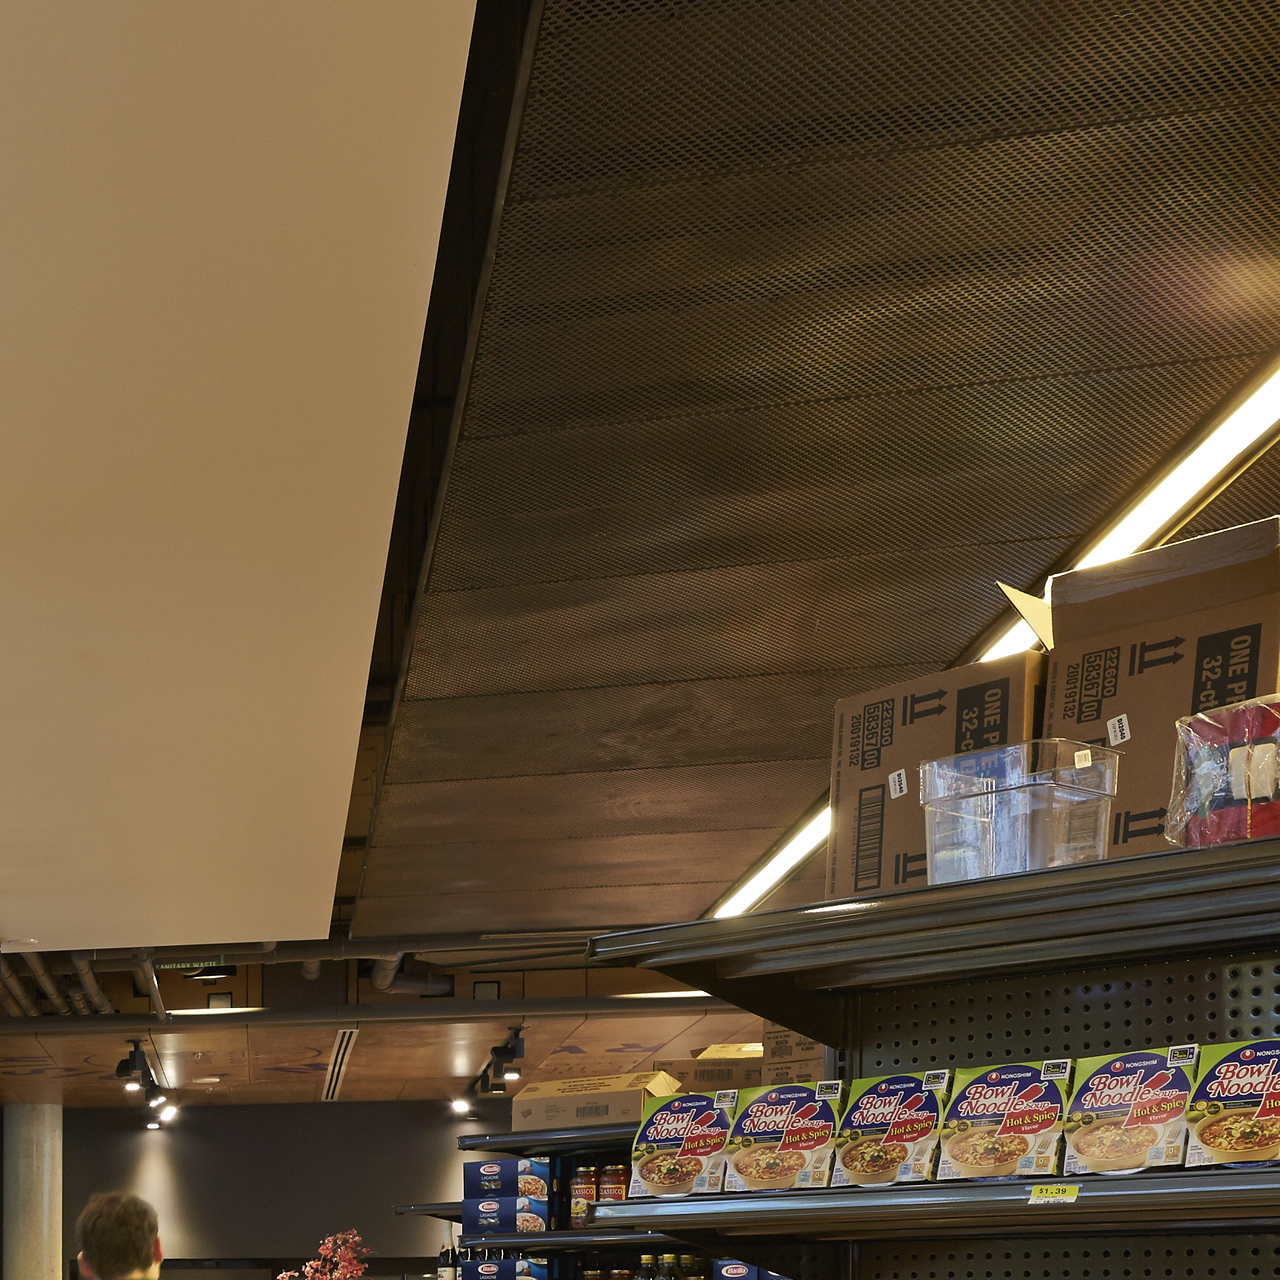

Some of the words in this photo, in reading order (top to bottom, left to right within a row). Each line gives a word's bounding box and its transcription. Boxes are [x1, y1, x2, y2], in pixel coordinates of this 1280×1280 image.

[1229, 634, 1250, 674] ONE
[1082, 653, 1104, 723] 5836700
[1101, 649, 1119, 697] 22600
[983, 687, 1002, 726] ONE
[1063, 663, 1079, 720] 20019132
[864, 704, 881, 770] 5836700
[881, 701, 892, 747] 22600
[849, 714, 861, 767] 20019132
[1126, 1060, 1158, 1069] NONGSHIM
[966, 1081, 1020, 1101] Bowl
[1090, 1070, 1144, 1093] Bowl
[957, 1097, 1025, 1116] Noodle
[1082, 1087, 1152, 1109] Noodle
[1133, 1106, 1148, 1118] Hot
[1151, 1104, 1158, 1113] &
[1161, 1098, 1186, 1113] Spicy
[1007, 1116, 1021, 1127] Hot
[1032, 1110, 1057, 1124] Spicy
[1039, 1187, 1067, 1195] $1.39
